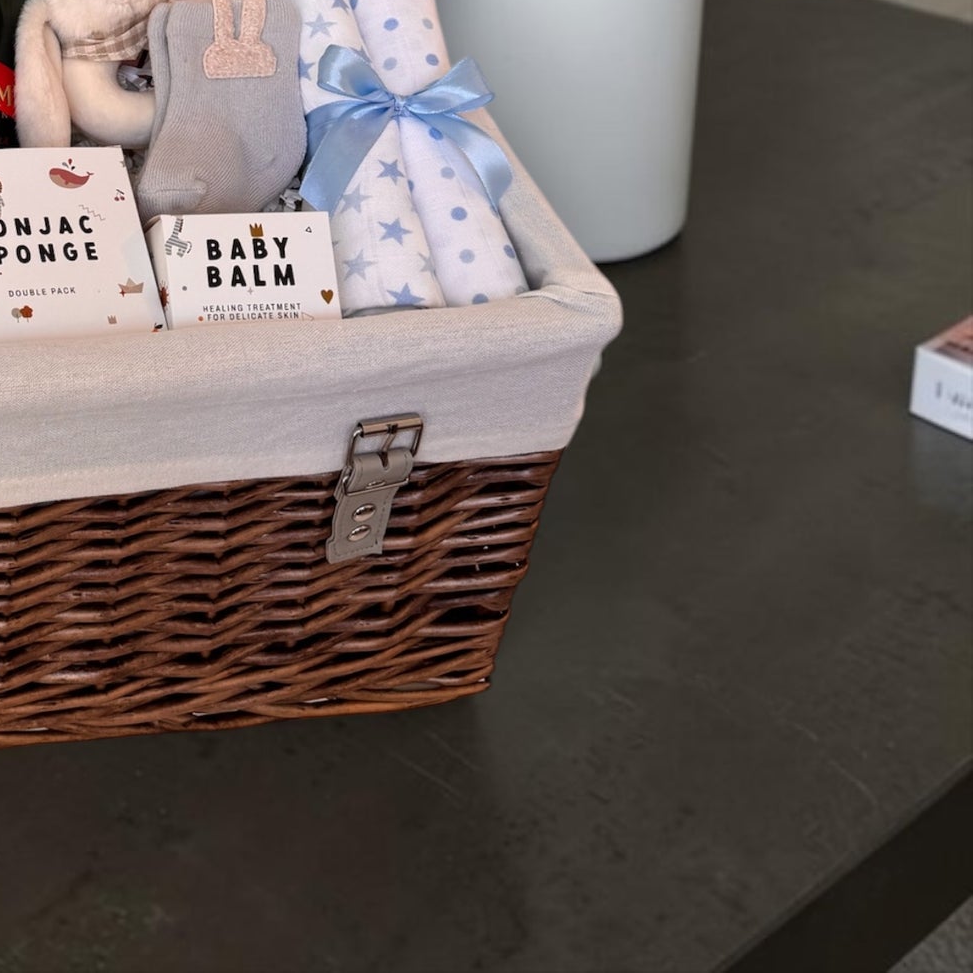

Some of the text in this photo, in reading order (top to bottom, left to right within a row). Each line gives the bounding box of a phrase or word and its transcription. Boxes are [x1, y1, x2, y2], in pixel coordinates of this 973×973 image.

[206, 237, 288, 260] BABY
[206, 264, 295, 288] BALM
[8, 287, 76, 298] DOUBLE PACK
[203, 303, 301, 313] HEALING TREATMENT
[207, 311, 299, 321] FOR DELICATE SKIN
